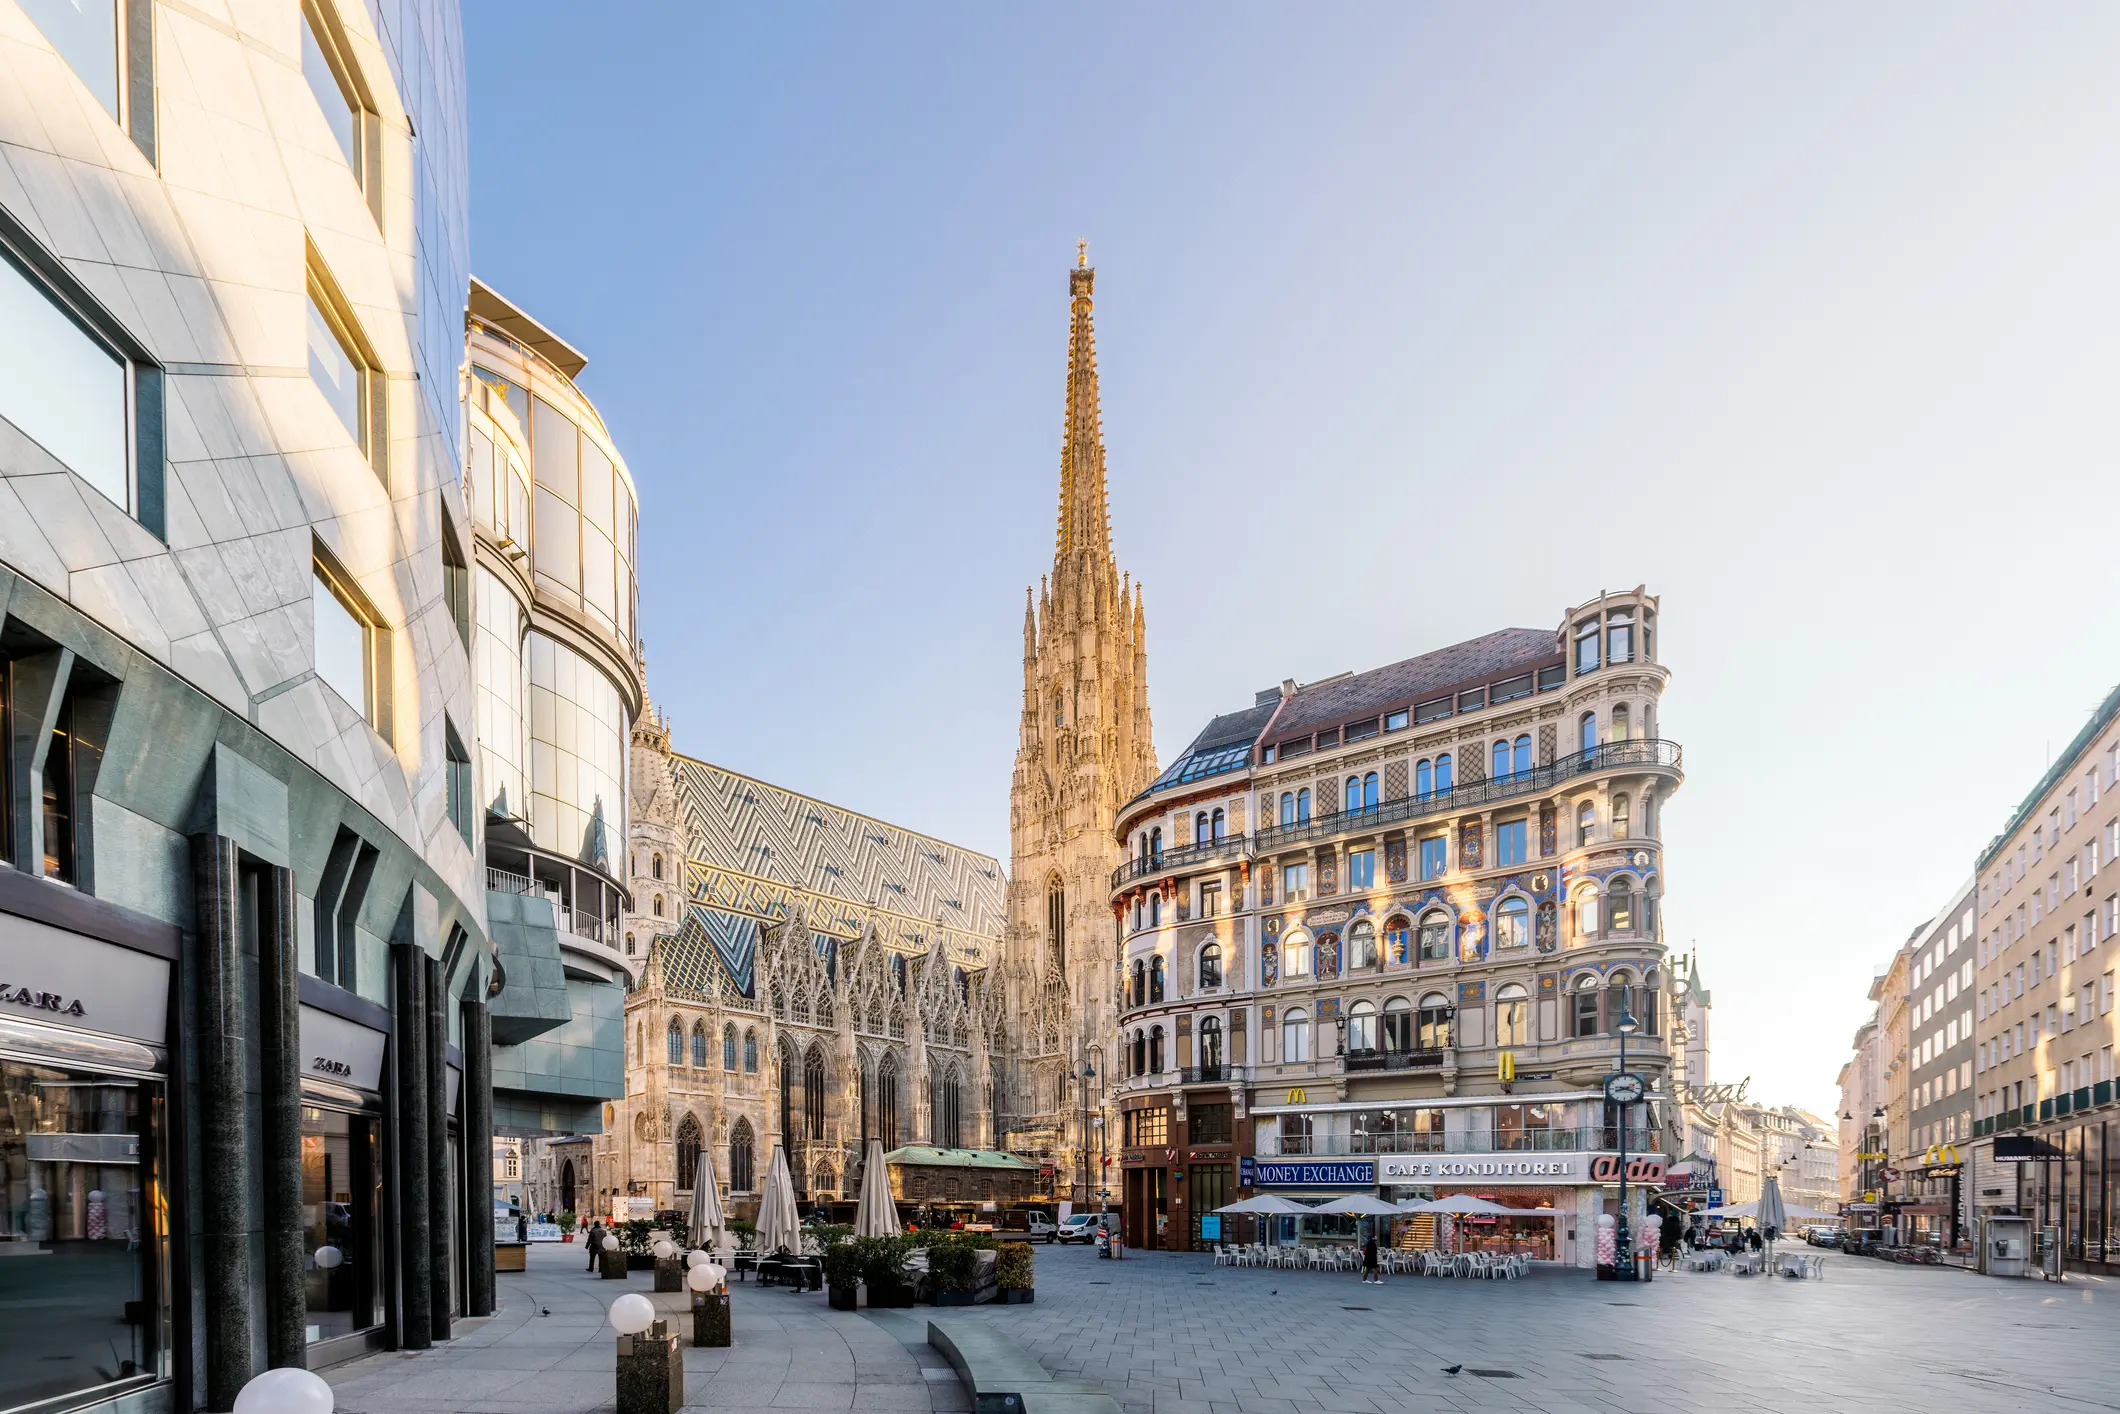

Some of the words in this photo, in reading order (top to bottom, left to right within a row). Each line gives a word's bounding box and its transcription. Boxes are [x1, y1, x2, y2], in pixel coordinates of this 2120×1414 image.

[312, 1056, 352, 1077] ZARA
[1256, 1166, 1300, 1182] MONEY
[1303, 1165, 1373, 1182] EXCHANGE
[1438, 1162, 1569, 1176] KONDITOREI
[1590, 1156, 1667, 1183] ada
